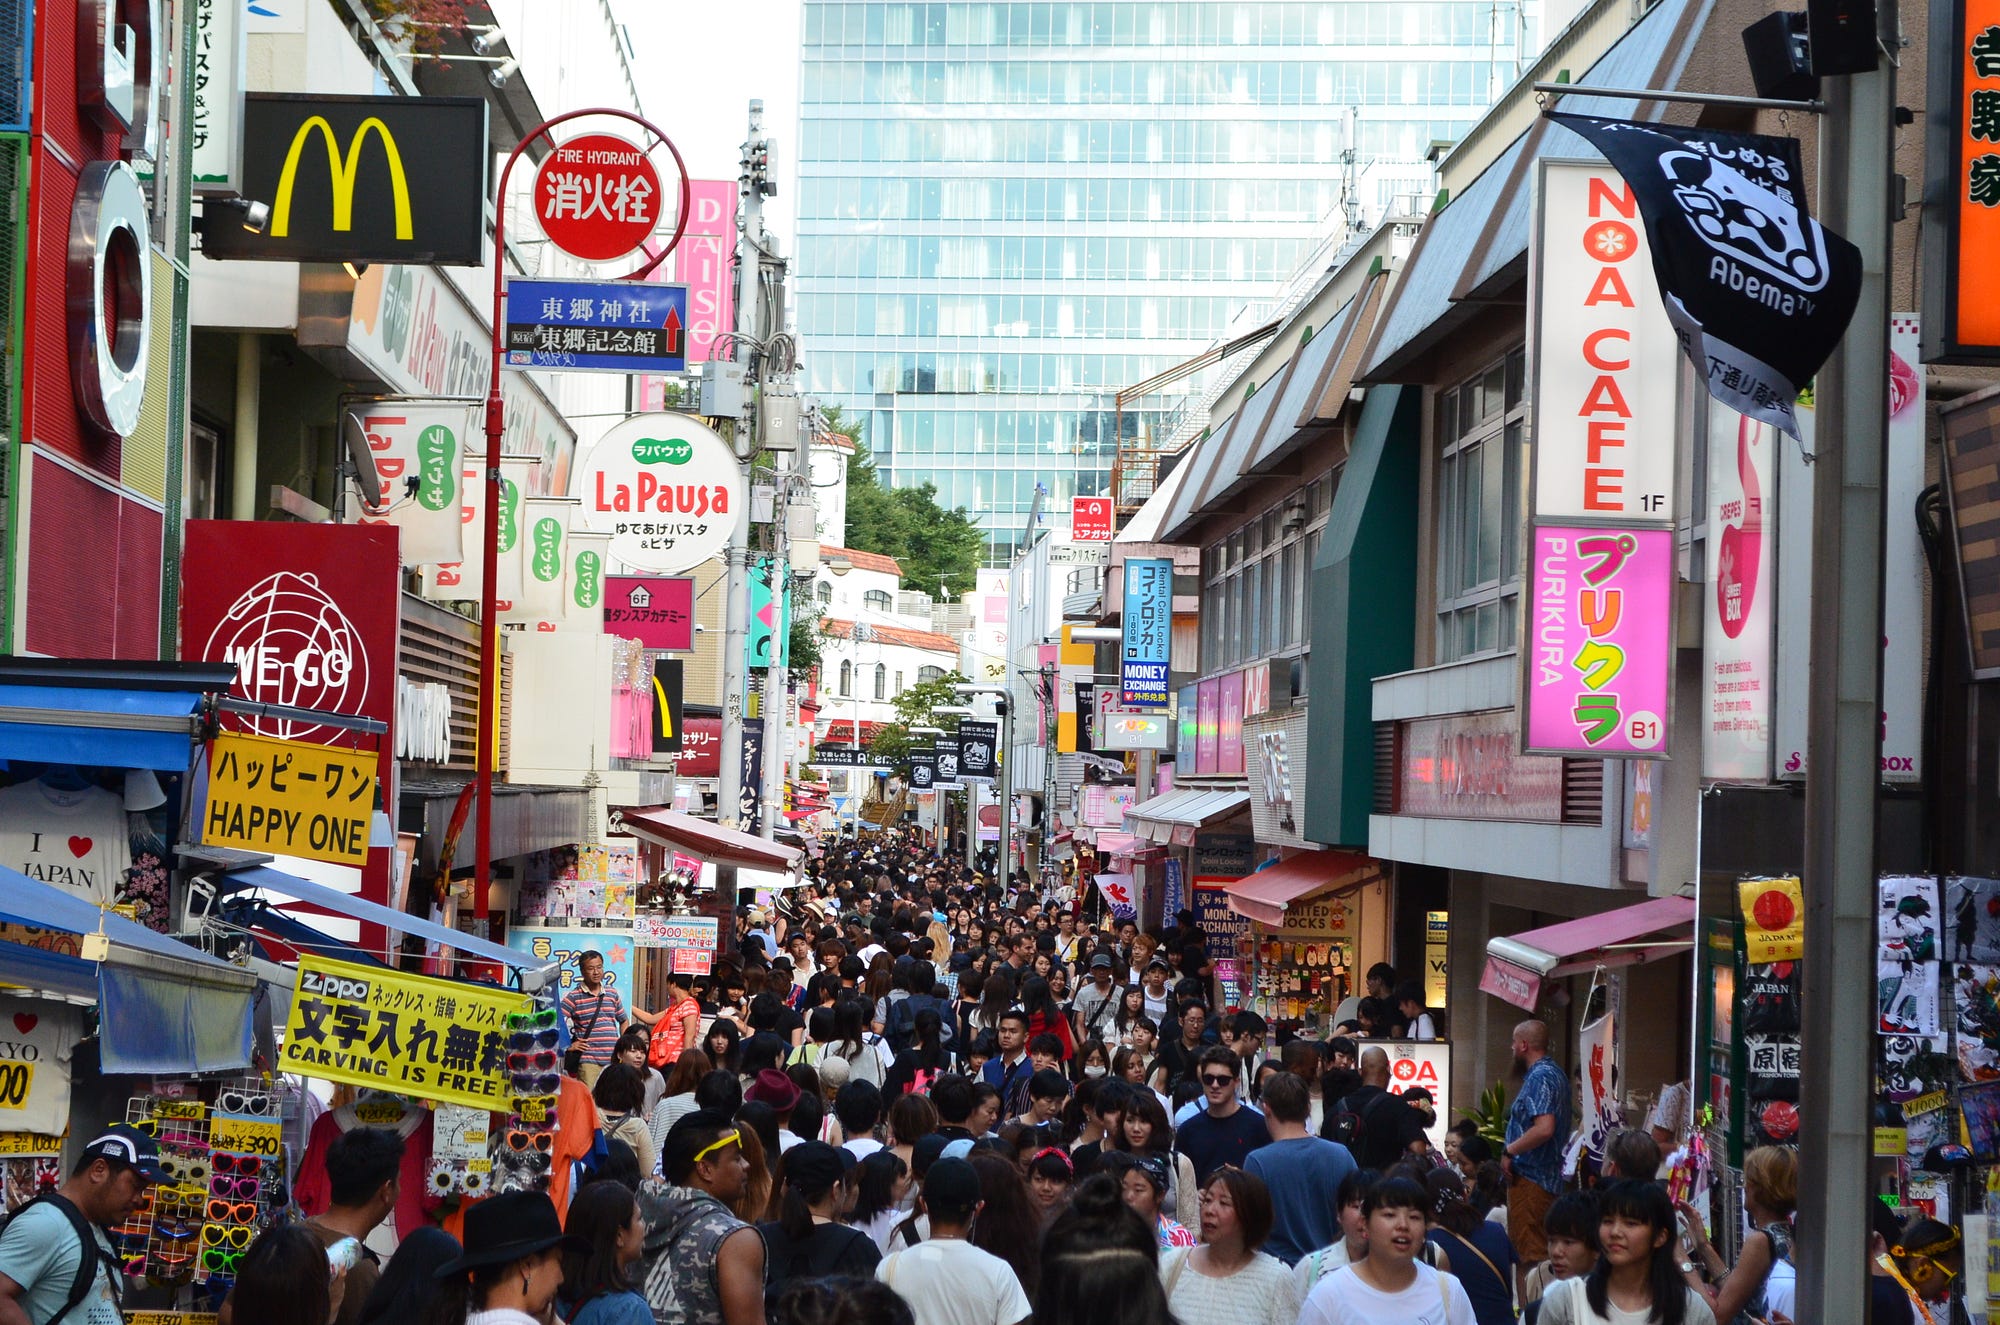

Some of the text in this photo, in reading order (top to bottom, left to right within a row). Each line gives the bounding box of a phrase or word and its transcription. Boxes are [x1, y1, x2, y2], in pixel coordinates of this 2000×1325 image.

[557, 149, 641, 166] FIRE HYDRANT
[545, 171, 653, 223] 消火栓
[692, 199, 722, 346] DAISO
[540, 297, 651, 323] 東郷神社
[539, 327, 656, 354] 東郷記念館
[1705, 355, 1790, 415] 下通り商店会
[633, 444, 690, 458] ラパウザ
[428, 428, 445, 509] ラパウザ
[596, 471, 728, 518] La Pausa
[1641, 494, 1665, 512] 1F
[616, 522, 708, 536] ゆであげパスタ
[1081, 530, 1110, 539] アガサ
[540, 520, 553, 581] ラパウザ
[1072, 549, 1108, 561] クリスティー
[581, 553, 594, 607] ラパウザ
[633, 594, 647, 604] 6F
[1727, 598, 1741, 621] BOX
[1140, 566, 1155, 658] コインロッカー
[1156, 567, 1167, 659] Rental Coin Locker
[1539, 537, 1567, 687] PURIKURA
[1573, 534, 1637, 746] プリクラ
[1128, 649, 1137, 657] 1F
[1125, 665, 1166, 679] MONEY
[1124, 681, 1166, 690] EXCHANGE
[1632, 721, 1658, 740] B1
[216, 751, 370, 802] ハッピーワン
[209, 800, 366, 856] HAPPY ONE
[31, 833, 40, 853] I
[1202, 857, 1218, 865] Coin
[23, 862, 95, 888] JAPAN
[651, 927, 681, 937] ¥900
[1758, 934, 1795, 943] JAPAN
[1767, 946, 1794, 955] 日本
[1752, 983, 1790, 994] JAPAN
[288, 1044, 497, 1097] CARVING IS FREE
[1393, 1059, 1438, 1081] OA
[1753, 1048, 1799, 1071] 原宿
[231, 1122, 274, 1136] サングラス
[237, 1133, 278, 1155] ¥390
